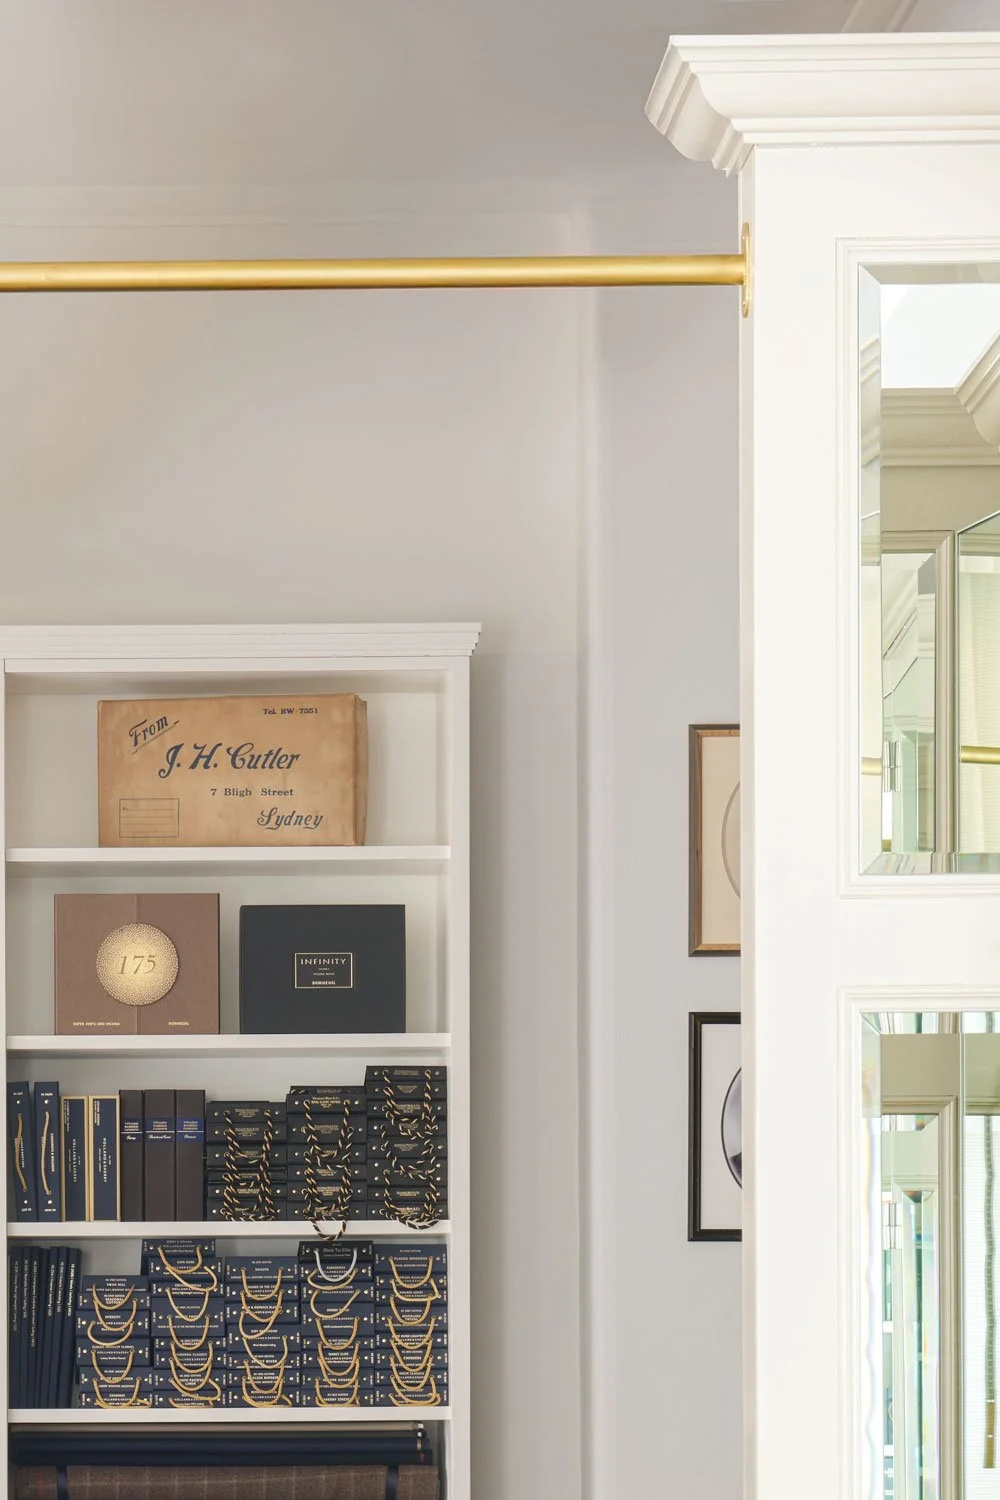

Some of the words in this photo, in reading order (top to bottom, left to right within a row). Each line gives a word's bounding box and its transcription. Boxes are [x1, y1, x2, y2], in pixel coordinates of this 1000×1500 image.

[129, 716, 168, 747] From
[158, 743, 185, 778] J.
[188, 743, 222, 770] H.
[226, 742, 300, 770] Cutler
[210, 788, 217, 796] 7
[224, 788, 252, 798] Bligh
[261, 788, 294, 796] Street
[257, 807, 323, 830] Sydney
[116, 954, 157, 975] 175
